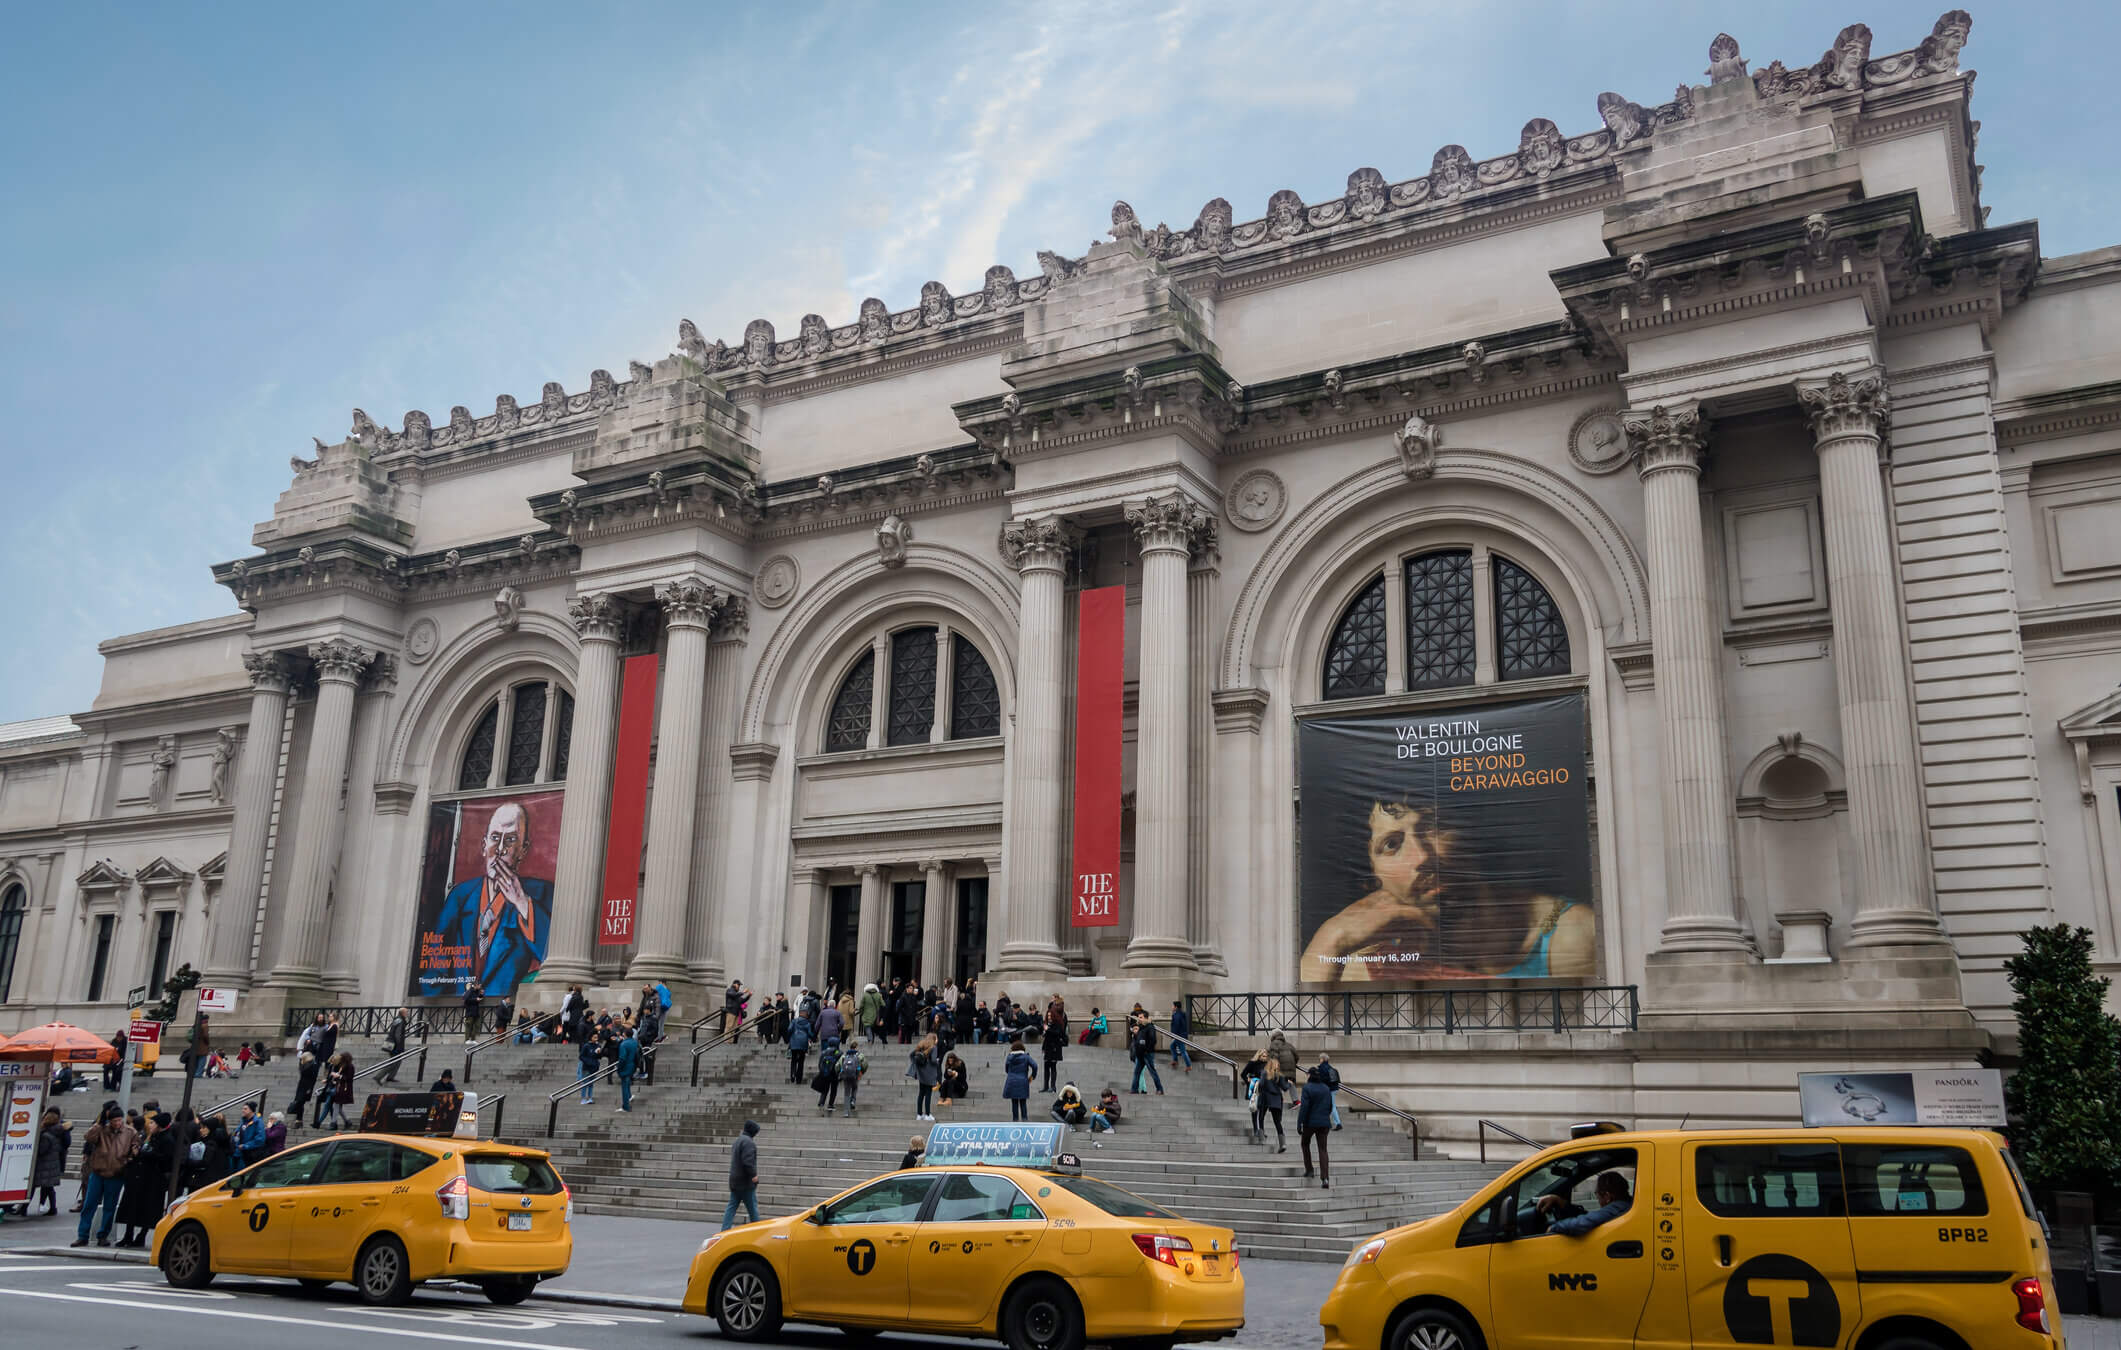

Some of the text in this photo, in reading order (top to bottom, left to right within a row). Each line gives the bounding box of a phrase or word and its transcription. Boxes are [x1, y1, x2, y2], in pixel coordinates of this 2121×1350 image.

[1396, 720, 1480, 741] VALENTIN
[1397, 734, 1523, 759] DE BOULOGNE
[1451, 753, 1526, 773] BEYOND
[1450, 768, 1569, 791] CARAVAGGIO
[1079, 873, 1113, 894] THE
[608, 899, 631, 917] THE
[1078, 895, 1113, 916] MET
[605, 918, 631, 935] MET
[423, 931, 444, 943] Max
[421, 944, 471, 956] Beckmann
[1318, 953, 1420, 965] Through January 16, 2017
[419, 956, 472, 968] in New York
[437, 976, 457, 984] February
[941, 1127, 1048, 1141] ROGUE ONE
[255, 1208, 266, 1229] T
[1938, 1227, 1989, 1242] 8P82
[854, 1246, 870, 1271] T
[1548, 1273, 1598, 1291] NYC
[1747, 1277, 1810, 1346] T
